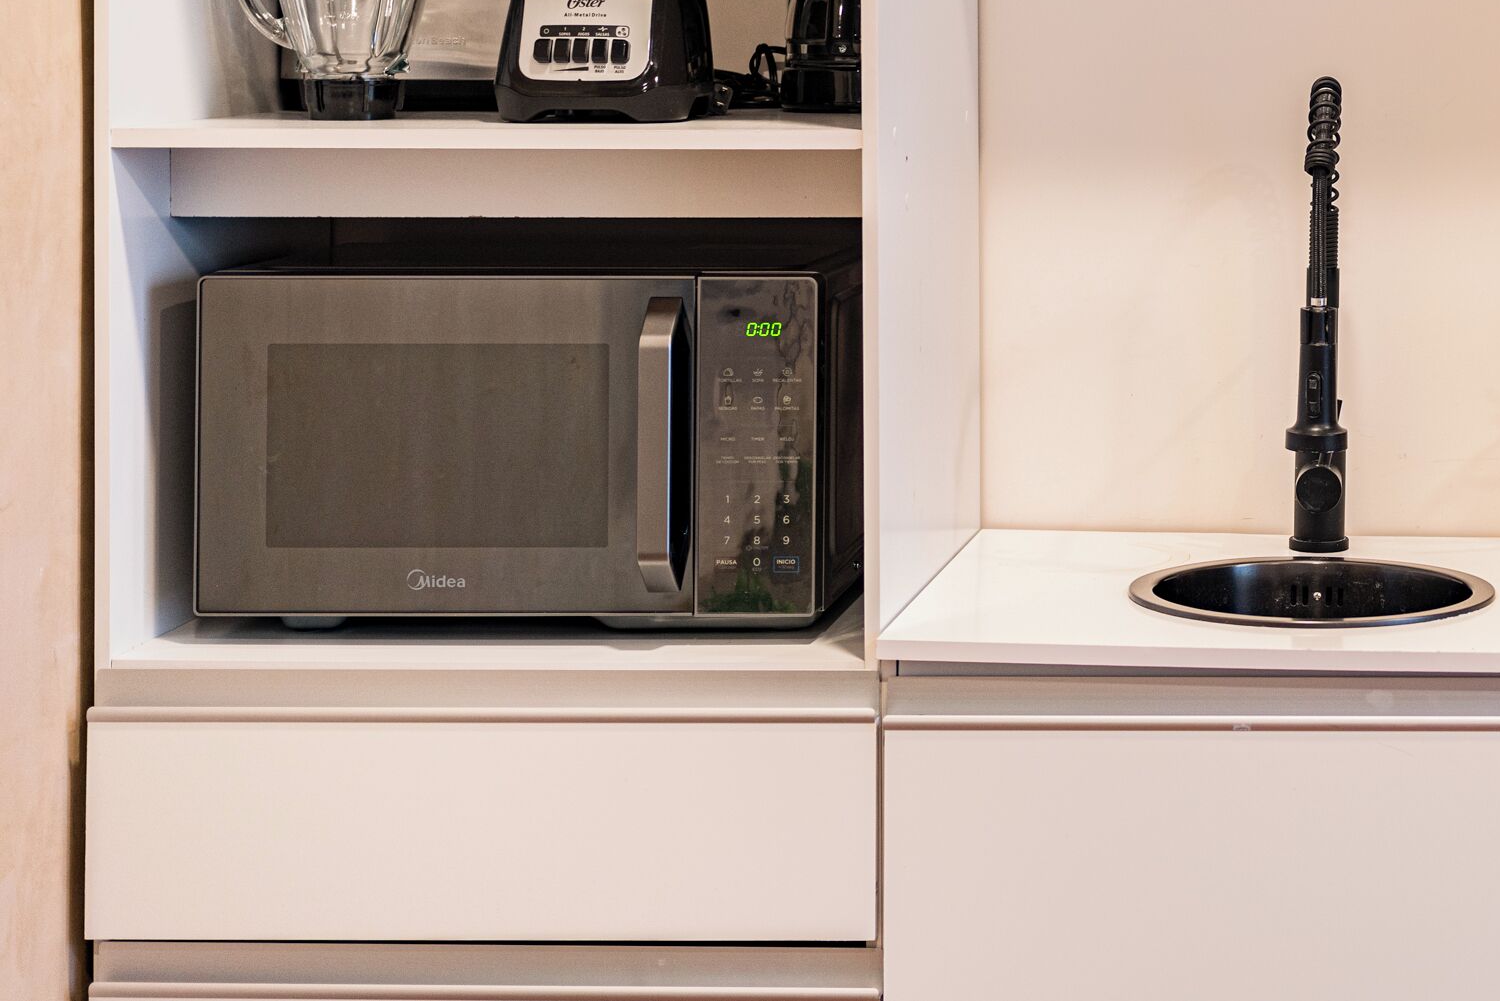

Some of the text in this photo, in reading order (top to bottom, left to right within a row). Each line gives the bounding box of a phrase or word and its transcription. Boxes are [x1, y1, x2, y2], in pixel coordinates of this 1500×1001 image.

[745, 322, 782, 337] 0:00
[725, 495, 790, 504] 1 2 3
[723, 516, 790, 524] 4 5 6
[724, 536, 790, 545] 7 8 9
[753, 557, 761, 566] 0
[407, 572, 466, 589] Midea
